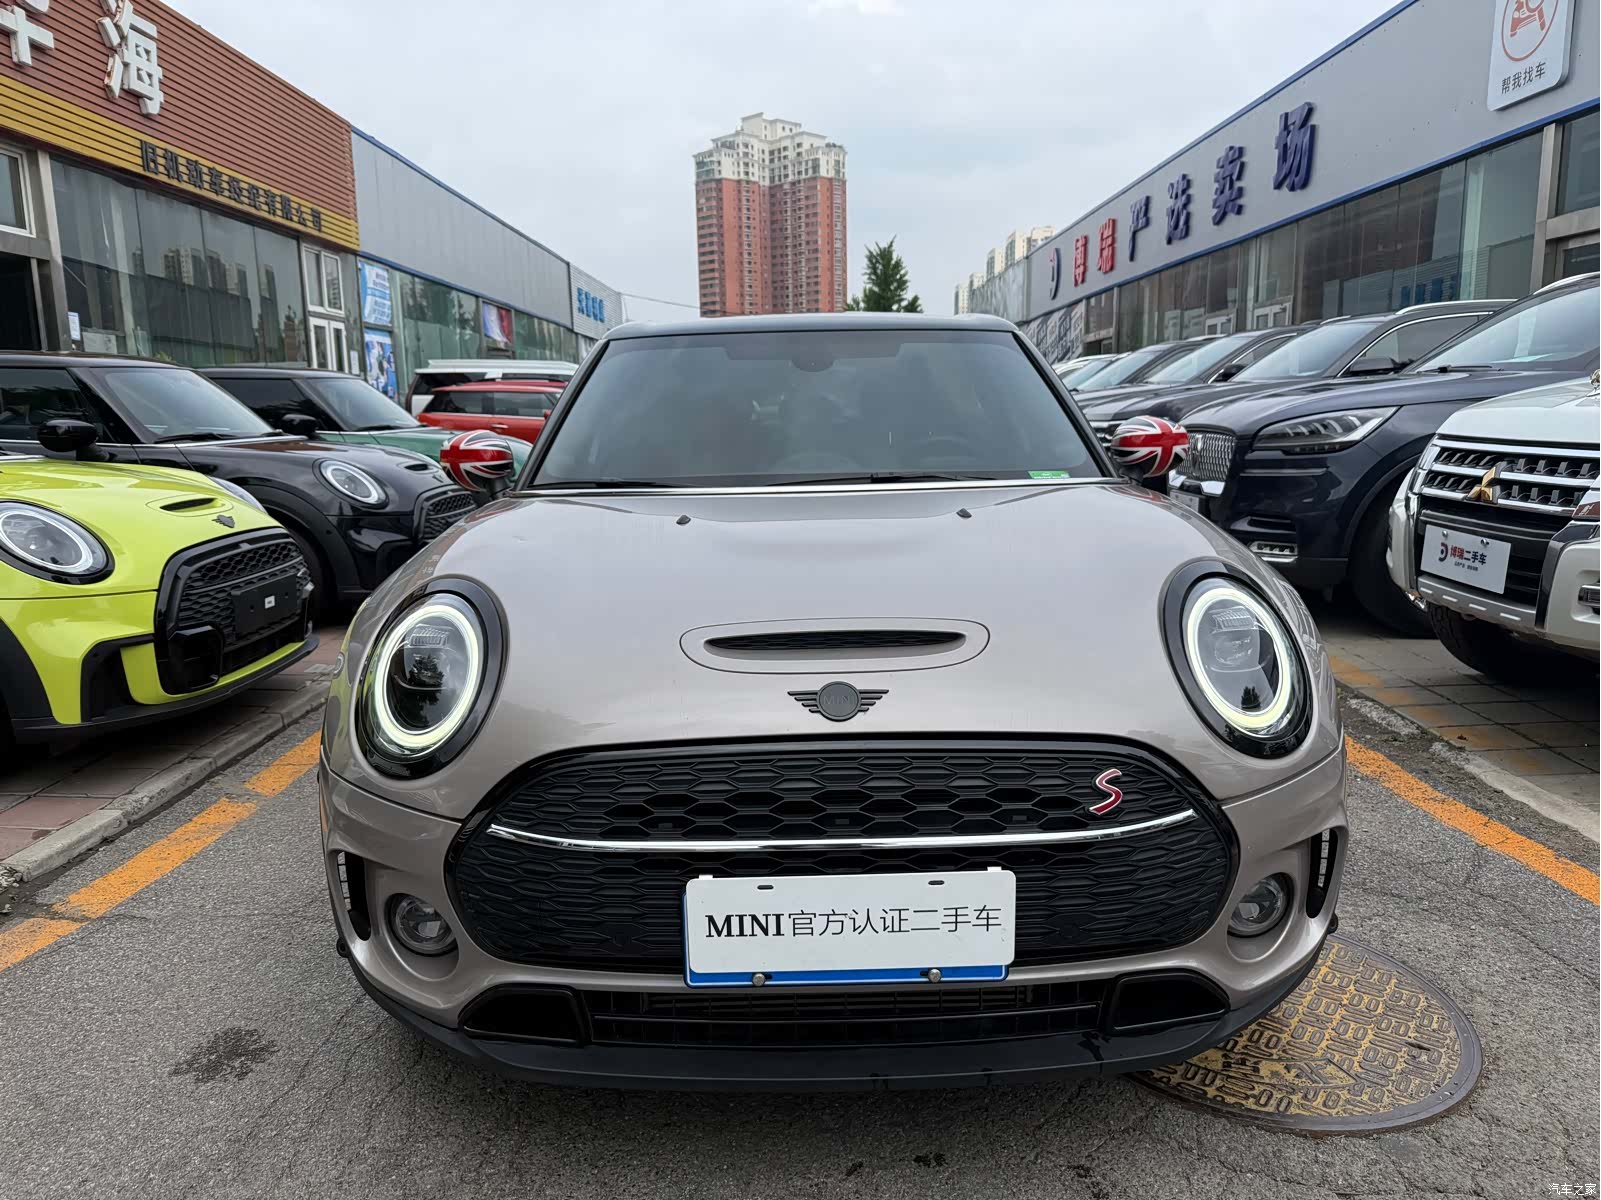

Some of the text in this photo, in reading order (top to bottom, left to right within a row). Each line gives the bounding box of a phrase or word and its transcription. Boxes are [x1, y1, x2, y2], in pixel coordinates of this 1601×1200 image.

[1501, 61, 1546, 95] 帮我找车
[1072, 101, 1317, 287] 博瑞严选卖场
[1450, 545, 1487, 566] 博瑞二手车
[1089, 768, 1123, 815] S
